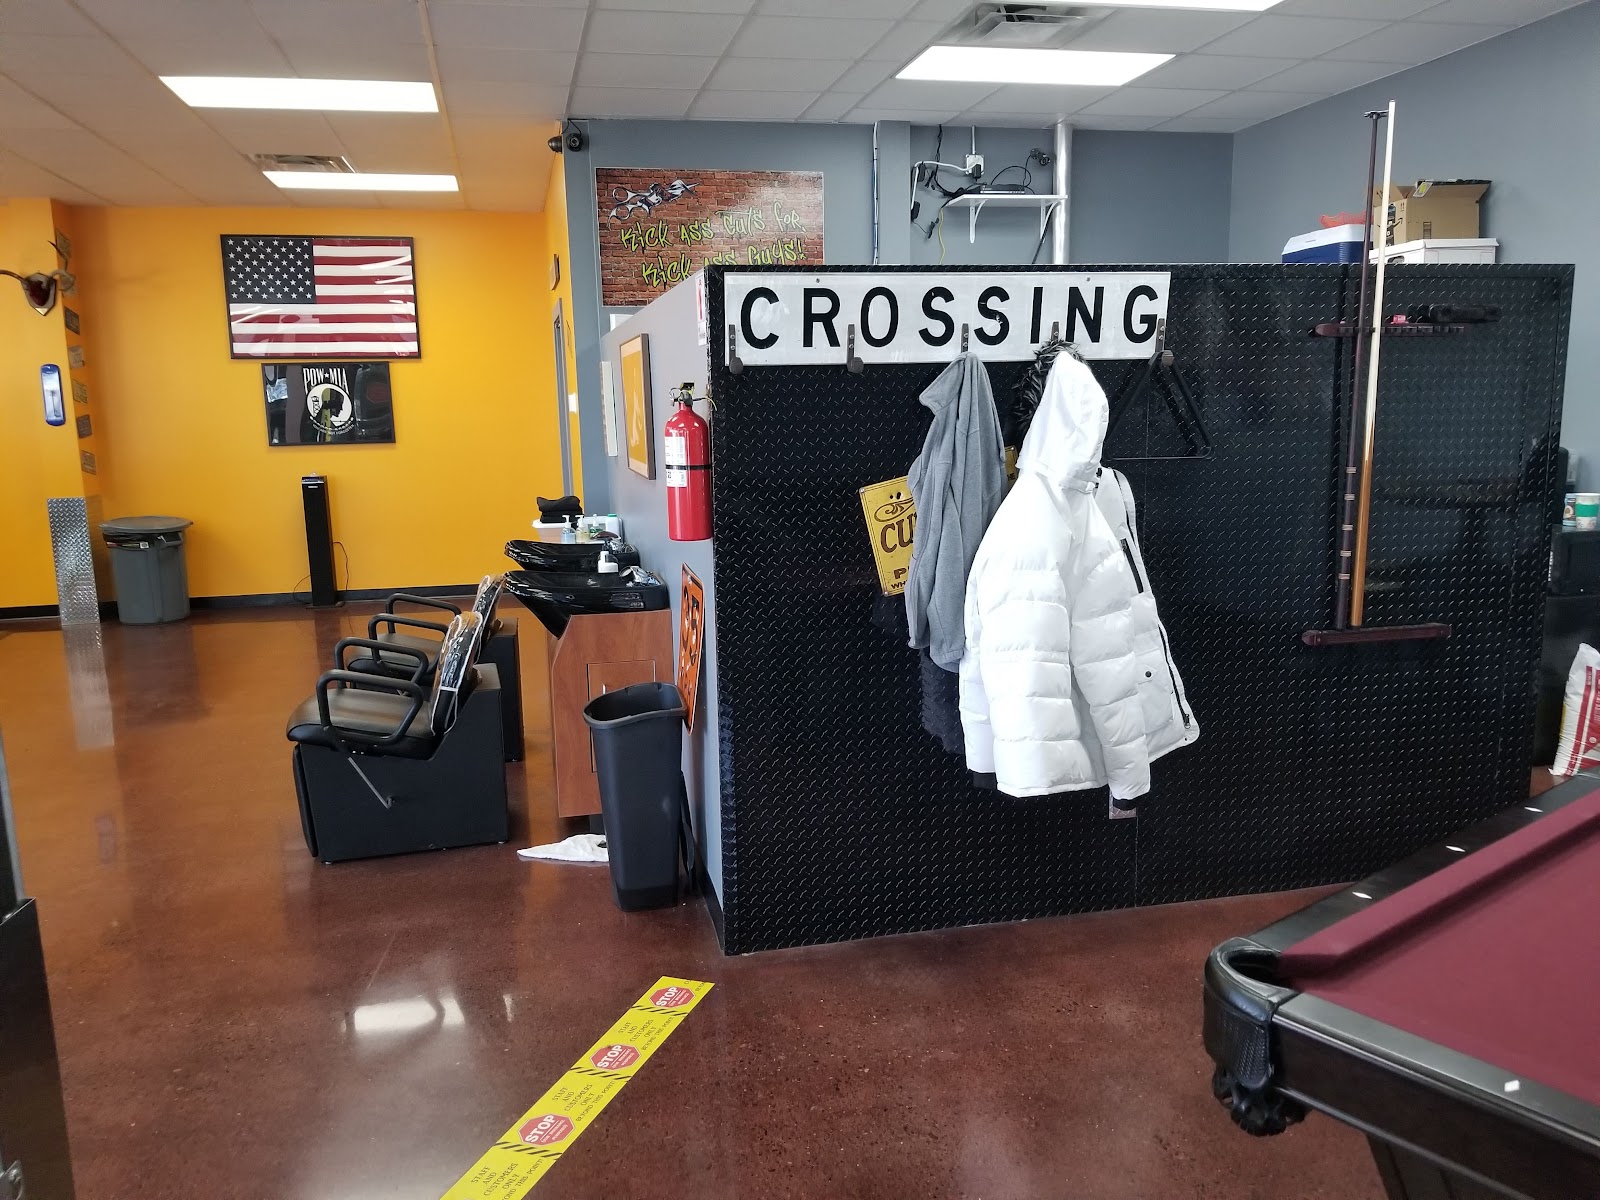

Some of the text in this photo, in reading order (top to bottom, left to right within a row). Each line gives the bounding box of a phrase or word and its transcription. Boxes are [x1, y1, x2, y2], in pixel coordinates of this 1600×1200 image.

[740, 285, 1159, 349] CROSSING
[302, 367, 350, 396] POW MIA
[655, 986, 679, 1007] STOP
[597, 1045, 623, 1068] STOP
[562, 1091, 575, 1103] AND
[564, 1084, 593, 1112] CUSTOMERS
[580, 1092, 595, 1106] ONLY
[524, 1115, 555, 1143] STOP
[471, 1166, 491, 1184] STAFF
[482, 1171, 497, 1185] AND
[483, 1163, 518, 1196] CUSTOMERS
[502, 1173, 520, 1190] ONLY
[502, 1188, 517, 1200] OND
